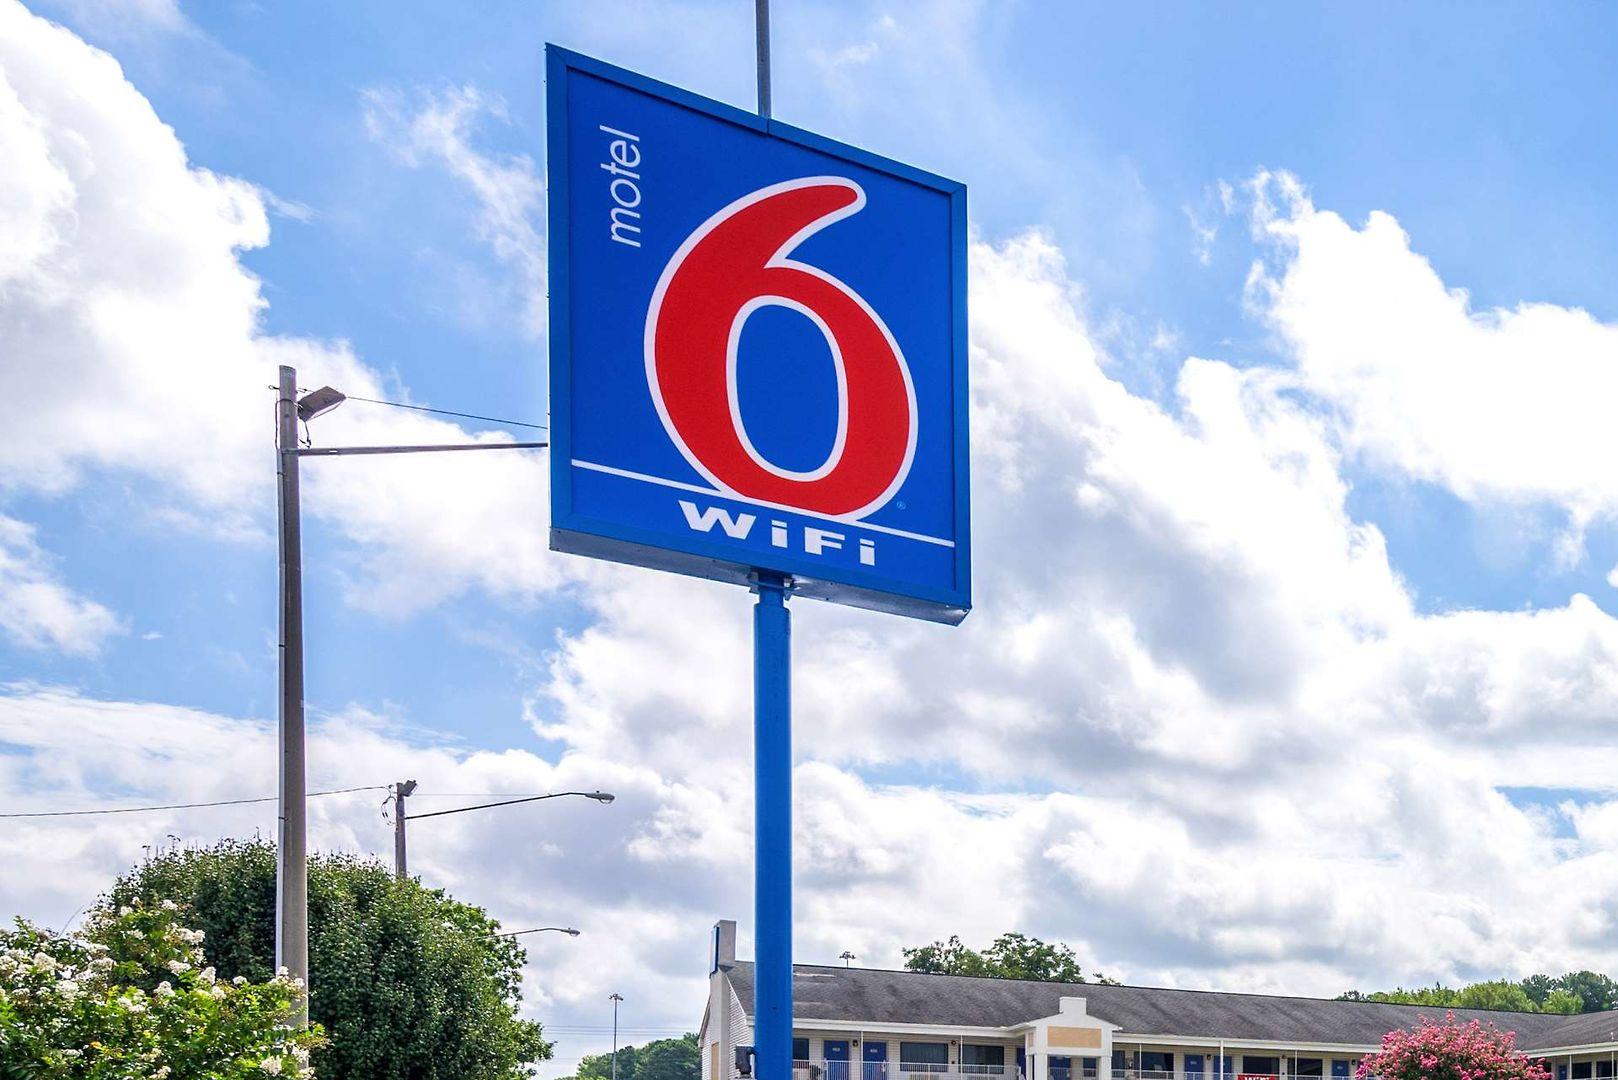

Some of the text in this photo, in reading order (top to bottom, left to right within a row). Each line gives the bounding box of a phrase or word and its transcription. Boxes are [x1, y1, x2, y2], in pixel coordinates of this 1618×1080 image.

[600, 125, 641, 247] motel
[644, 176, 918, 522] 6
[678, 500, 875, 566] WiFi
